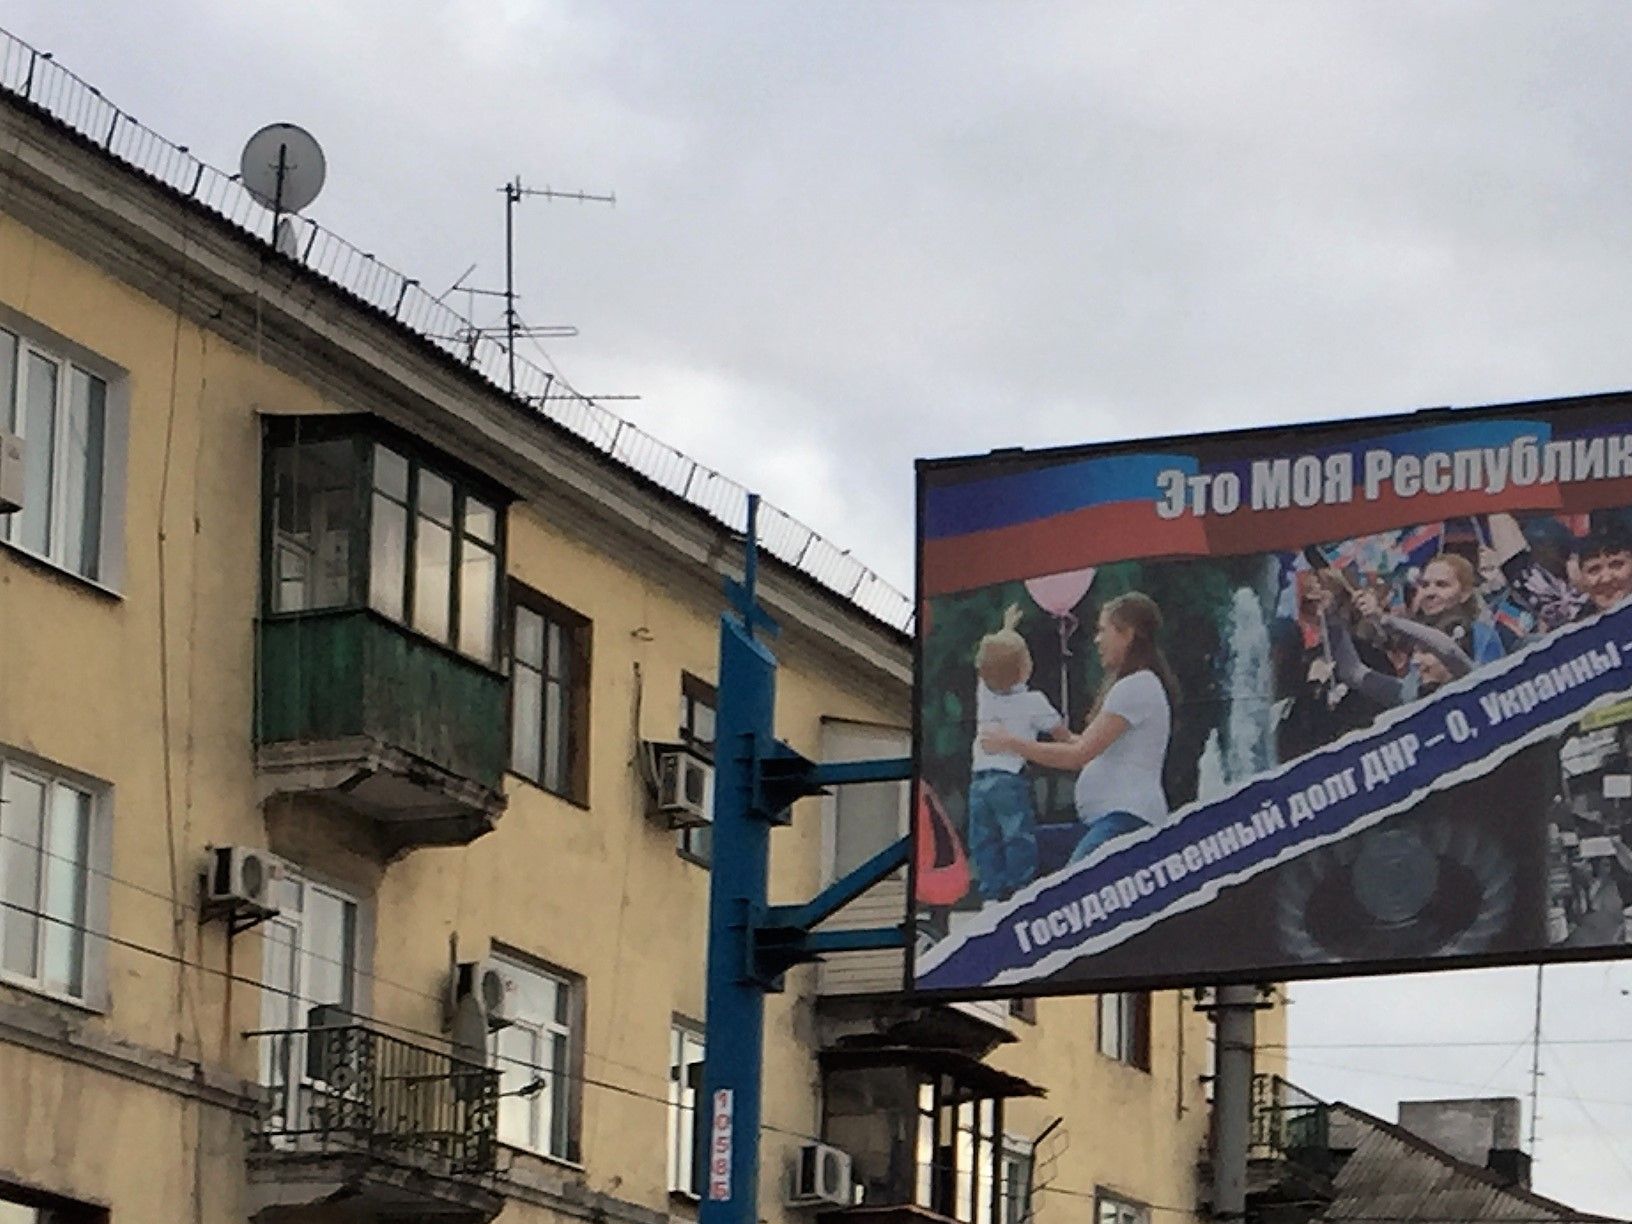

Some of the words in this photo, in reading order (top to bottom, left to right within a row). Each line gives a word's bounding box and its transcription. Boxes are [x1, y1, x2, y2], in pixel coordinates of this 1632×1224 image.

[1155, 468, 1240, 519] Это
[1251, 452, 1354, 511] МОЯ
[1013, 801, 1285, 954] Государственный
[1290, 767, 1360, 828] долг
[1362, 732, 1420, 791] ДНР
[1479, 641, 1623, 726] Украины
